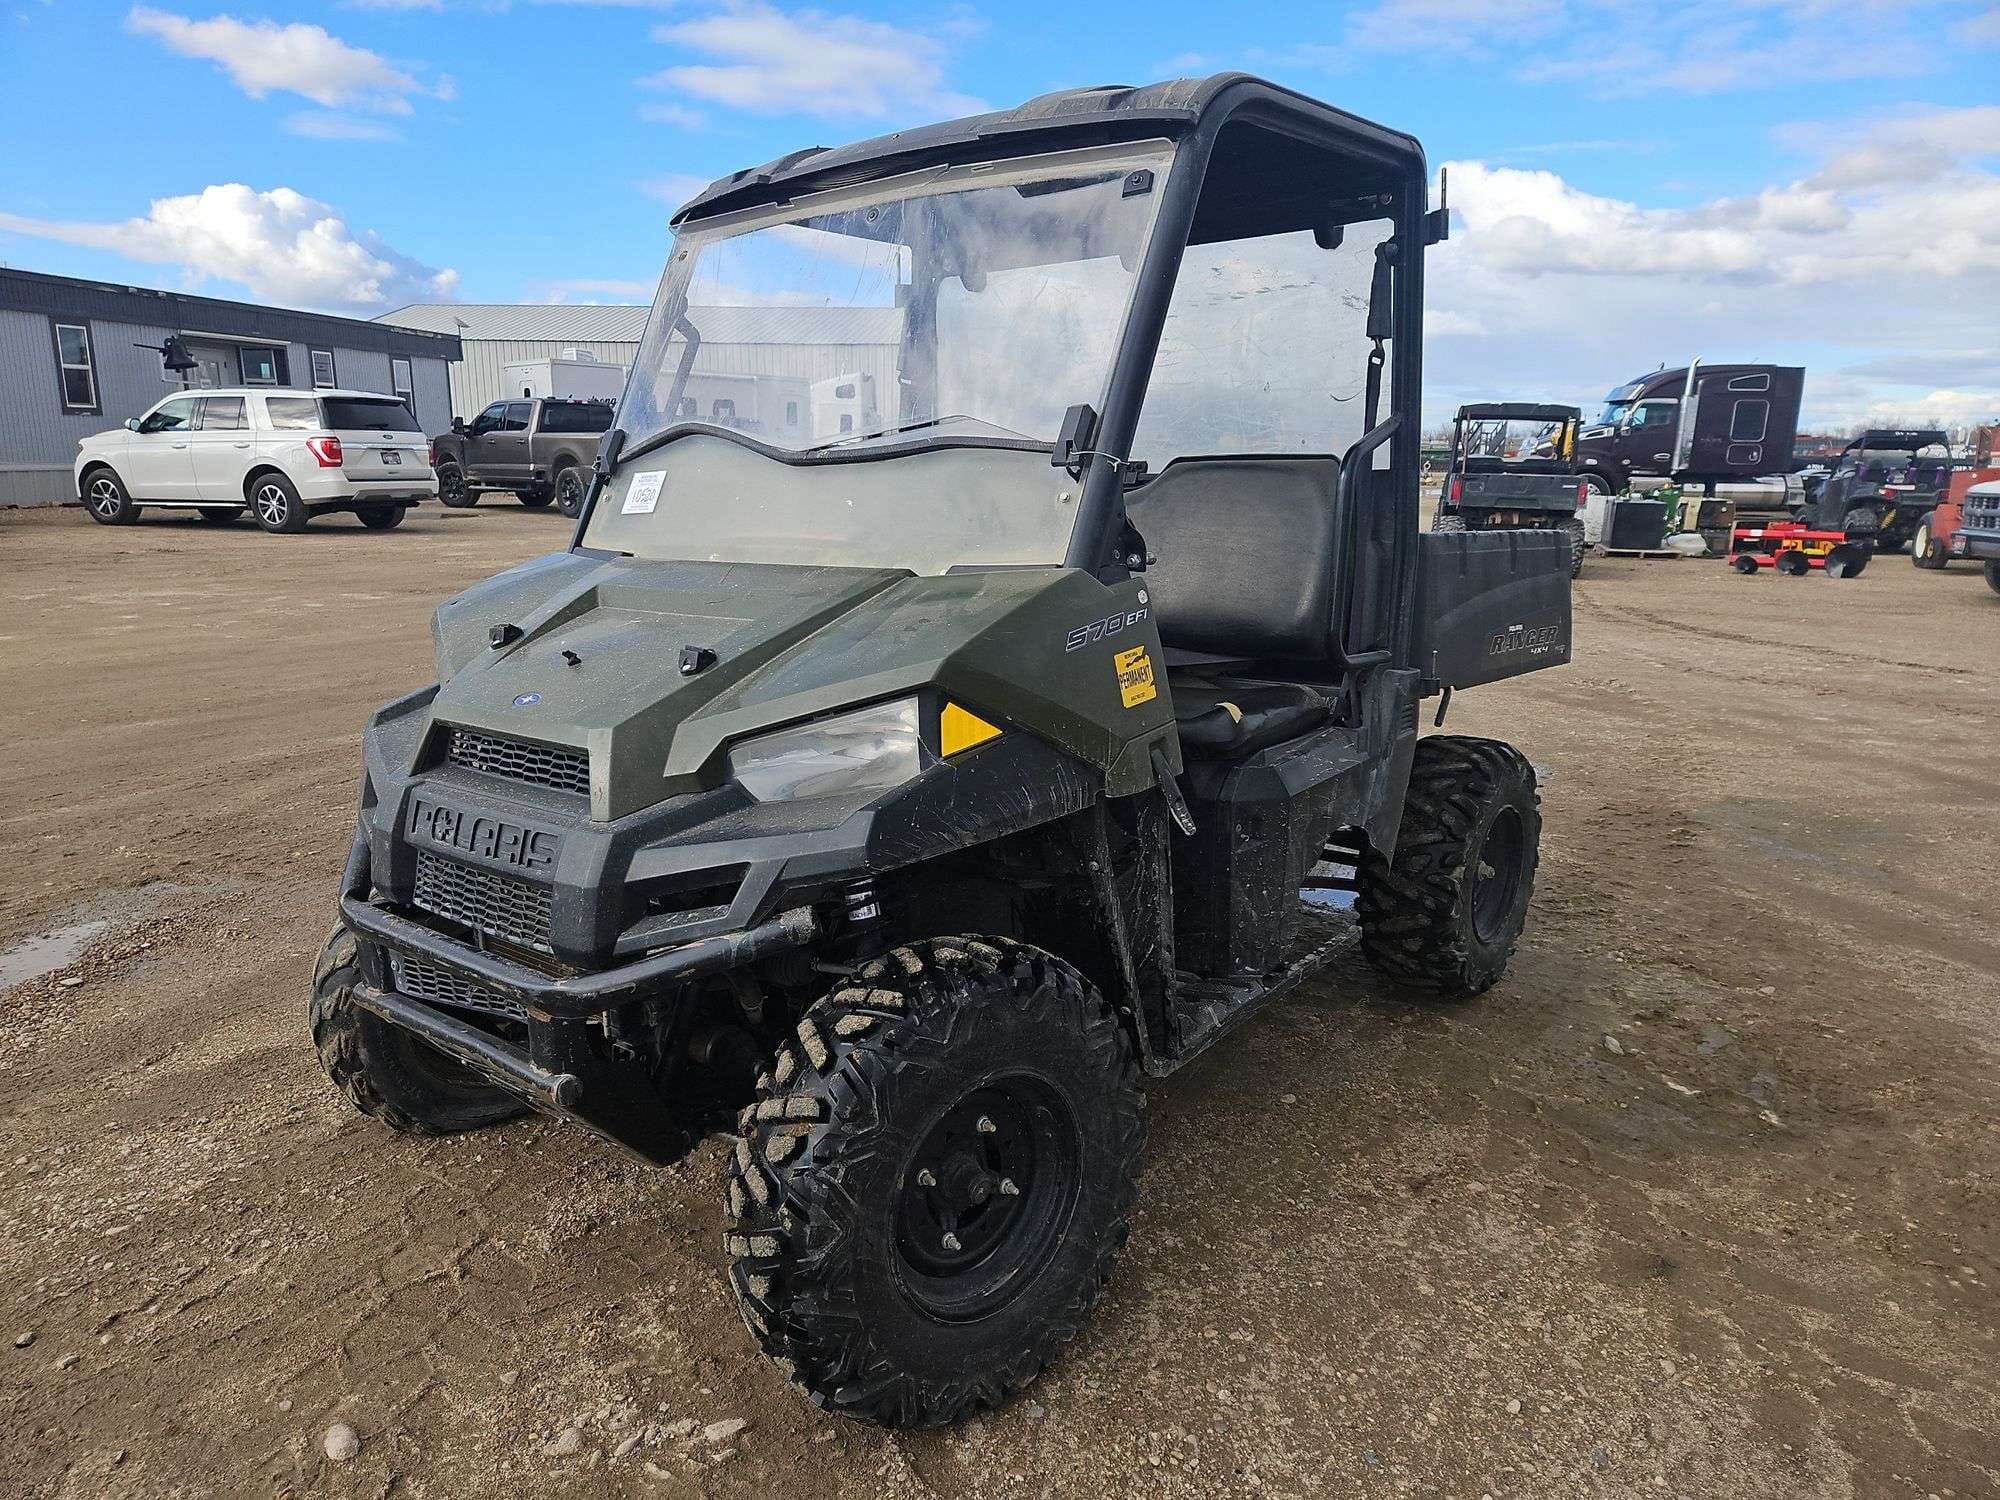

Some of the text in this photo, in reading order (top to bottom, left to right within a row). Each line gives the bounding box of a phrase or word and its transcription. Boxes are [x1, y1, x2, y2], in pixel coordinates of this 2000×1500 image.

[1065, 608, 1147, 652] 570 EFI
[1489, 626, 1558, 655] RANGER
[1119, 665, 1150, 690] PERMANENT
[411, 800, 559, 867] POLARIS
